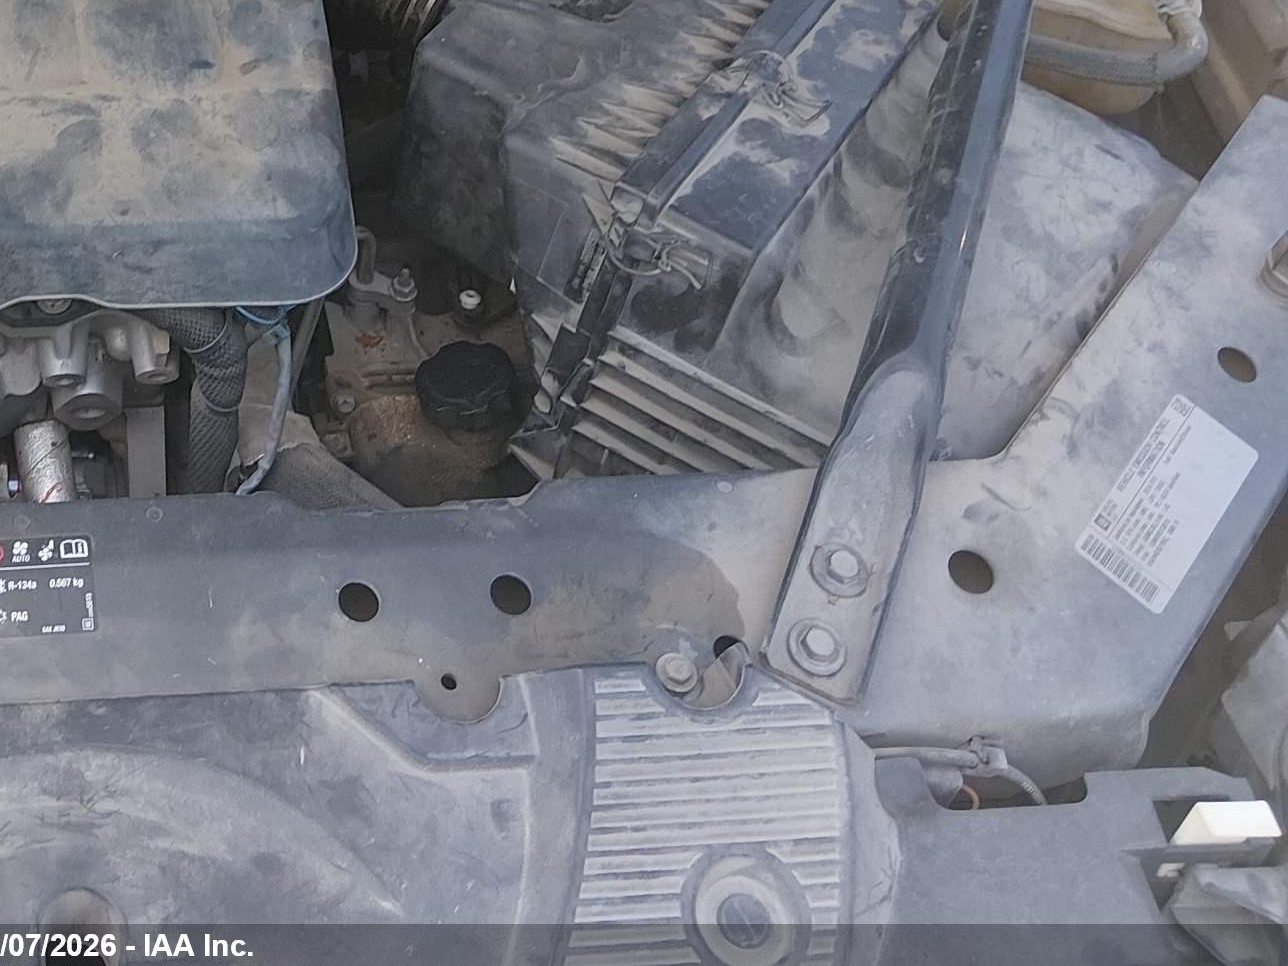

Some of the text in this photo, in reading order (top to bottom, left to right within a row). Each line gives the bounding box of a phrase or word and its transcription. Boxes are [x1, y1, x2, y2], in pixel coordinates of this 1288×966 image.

[12, 554, 31, 563] AUTO
[8, 580, 37, 591] R-134a
[72, 577, 84, 588] kg
[11, 611, 29, 622] PAG
